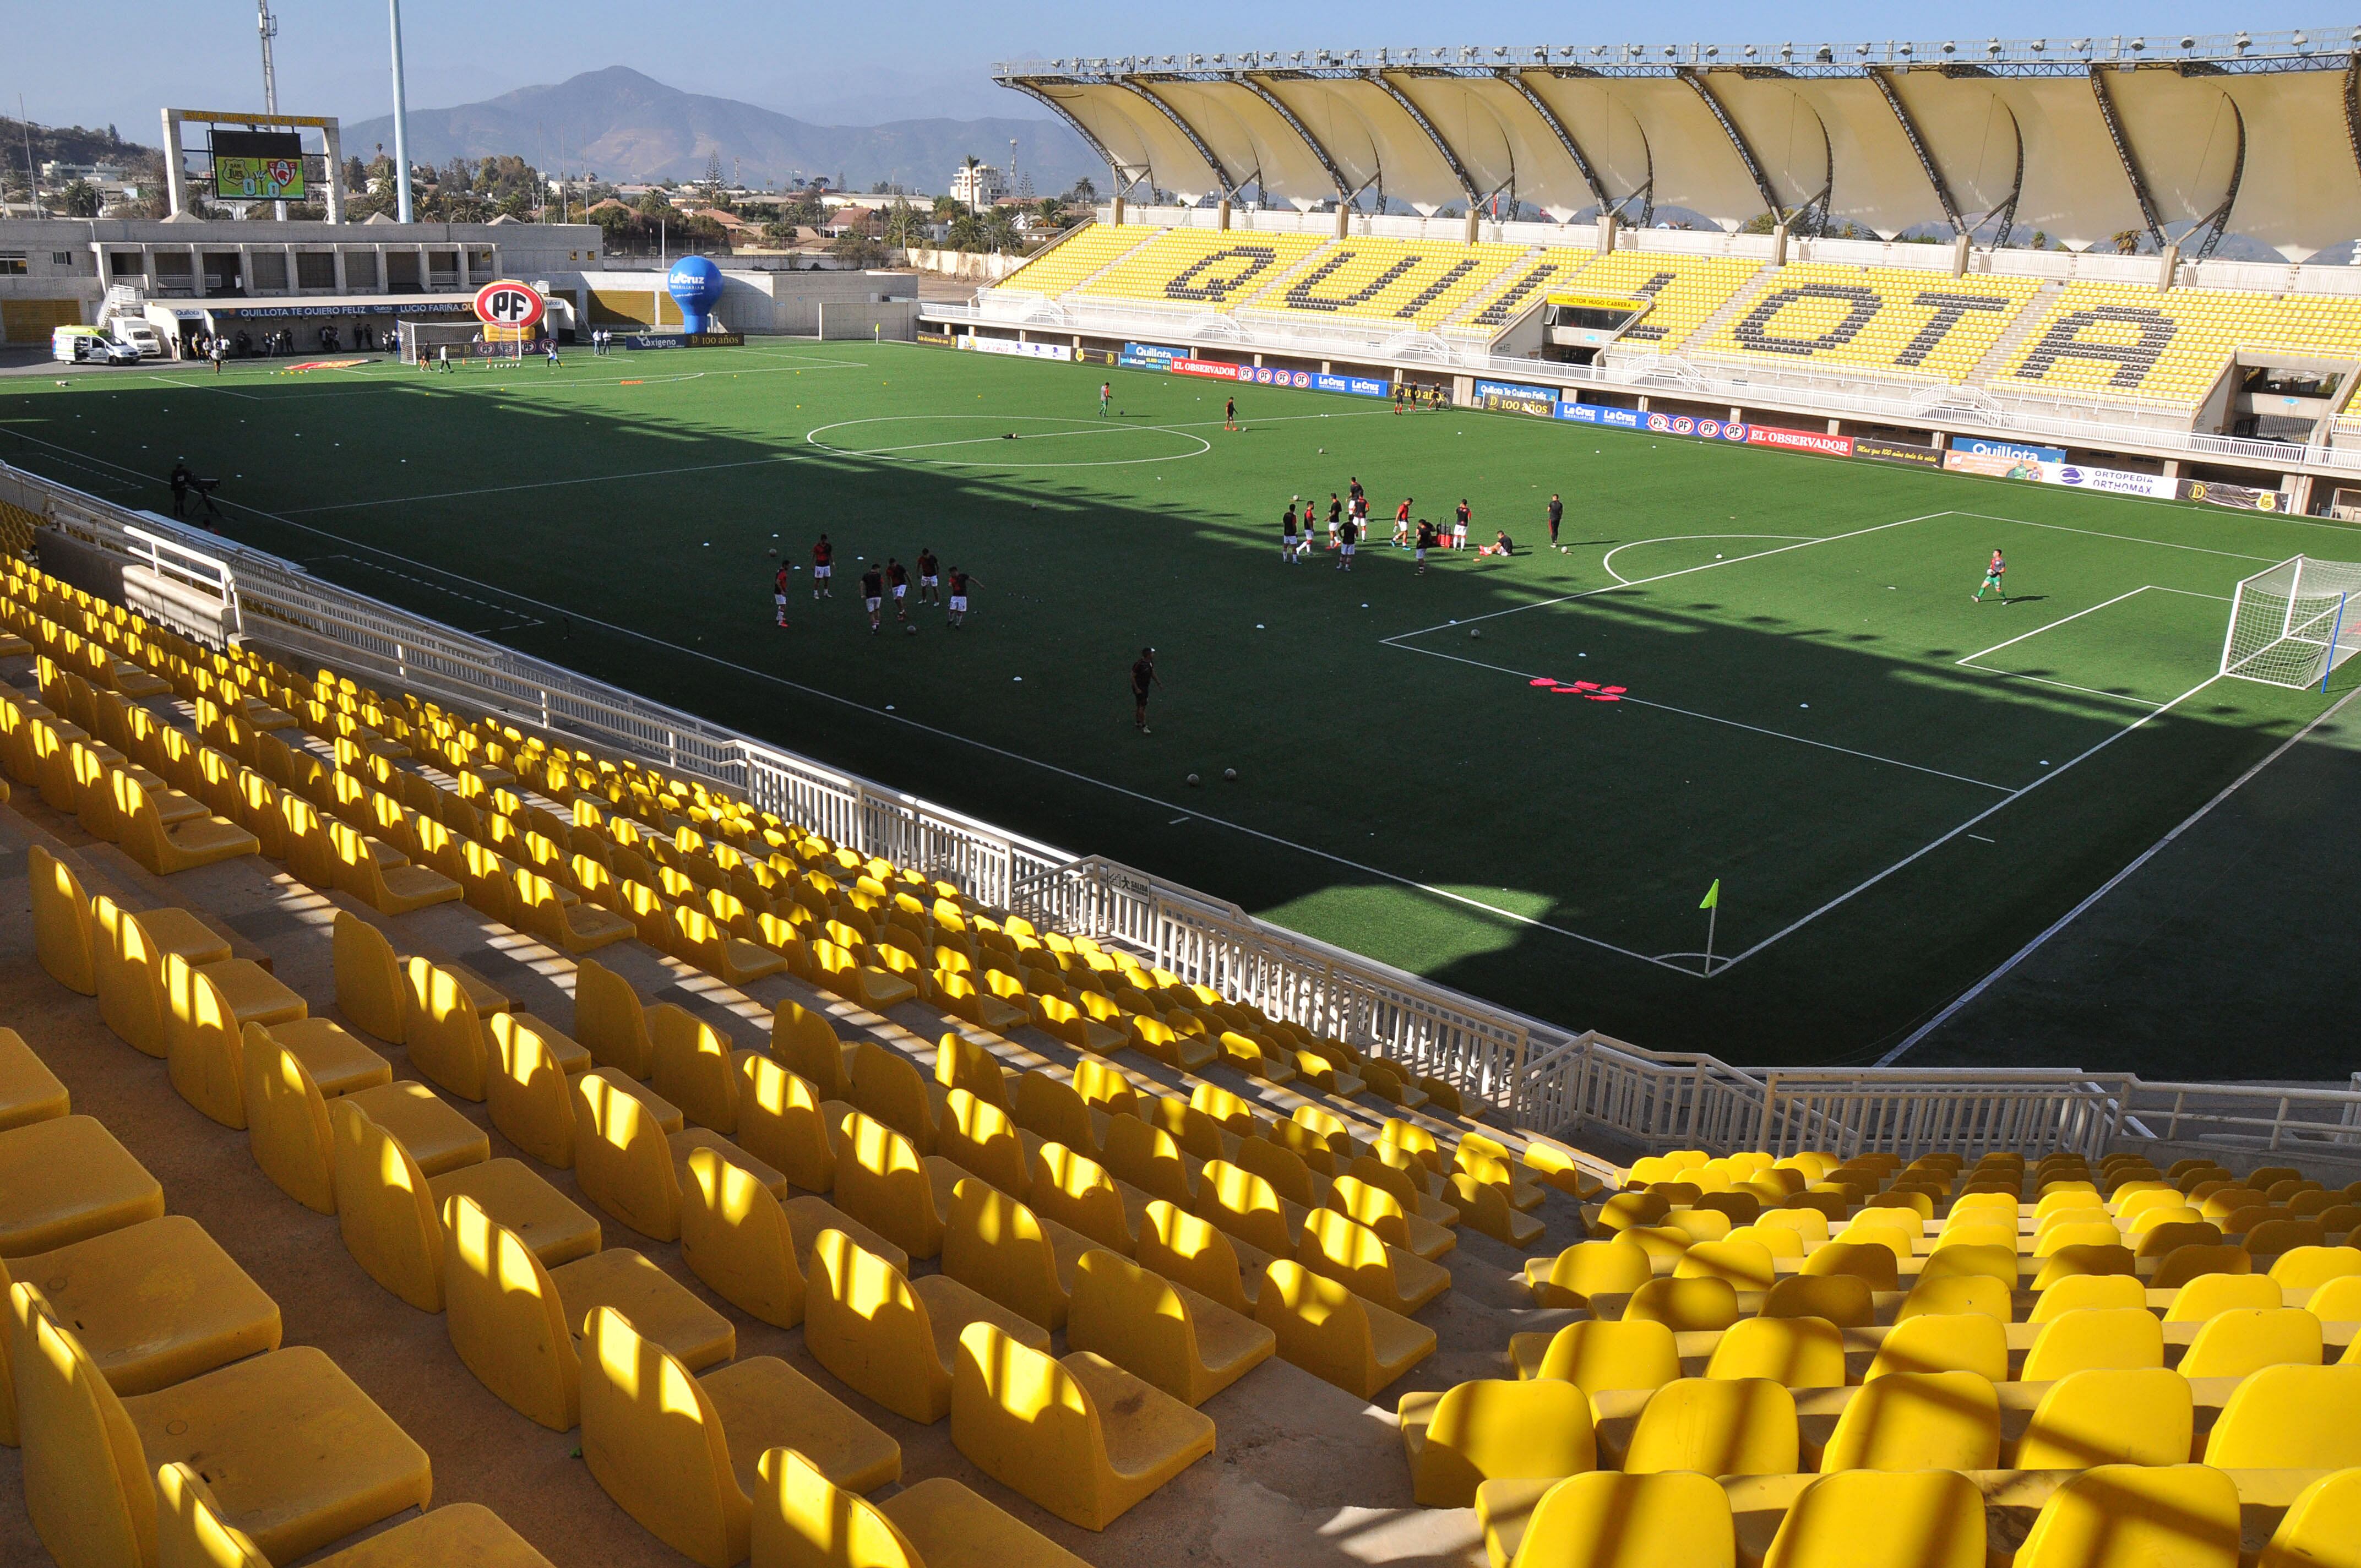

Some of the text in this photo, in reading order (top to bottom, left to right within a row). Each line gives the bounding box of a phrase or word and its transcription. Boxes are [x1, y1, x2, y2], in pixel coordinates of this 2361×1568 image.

[184, 111, 219, 122] ESTADIO
[243, 178, 256, 196] 0
[268, 181, 280, 198] 0
[241, 308, 289, 317] QUILLOTA
[304, 307, 340, 315] QUIERO
[342, 306, 366, 314] FELIZ
[400, 303, 459, 313] LUCIO FARIÑA
[492, 291, 526, 320] PF
[718, 335, 738, 344] años
[1135, 346, 1172, 358] Quillota
[1173, 361, 1236, 377] EL OBSERVADOR
[1243, 370, 1250, 378] PF
[1260, 372, 1268, 380] PF
[1279, 374, 1287, 383] PF
[1297, 375, 1305, 384] PF
[1481, 384, 1547, 400] Quillota Te Quiero Feliz
[1490, 396, 1498, 406] D
[1501, 400, 1520, 410] 100
[1678, 421, 1689, 431] PF
[1704, 423, 1714, 433] PF
[1729, 427, 1740, 437] PF
[1750, 430, 1849, 452] EL OBSERVADOR
[1972, 443, 2039, 463] Quillota
[2095, 470, 2153, 483] ORTOPEDIA
[2093, 479, 2152, 495] ORTHOMAX
[2191, 483, 2204, 499] D
